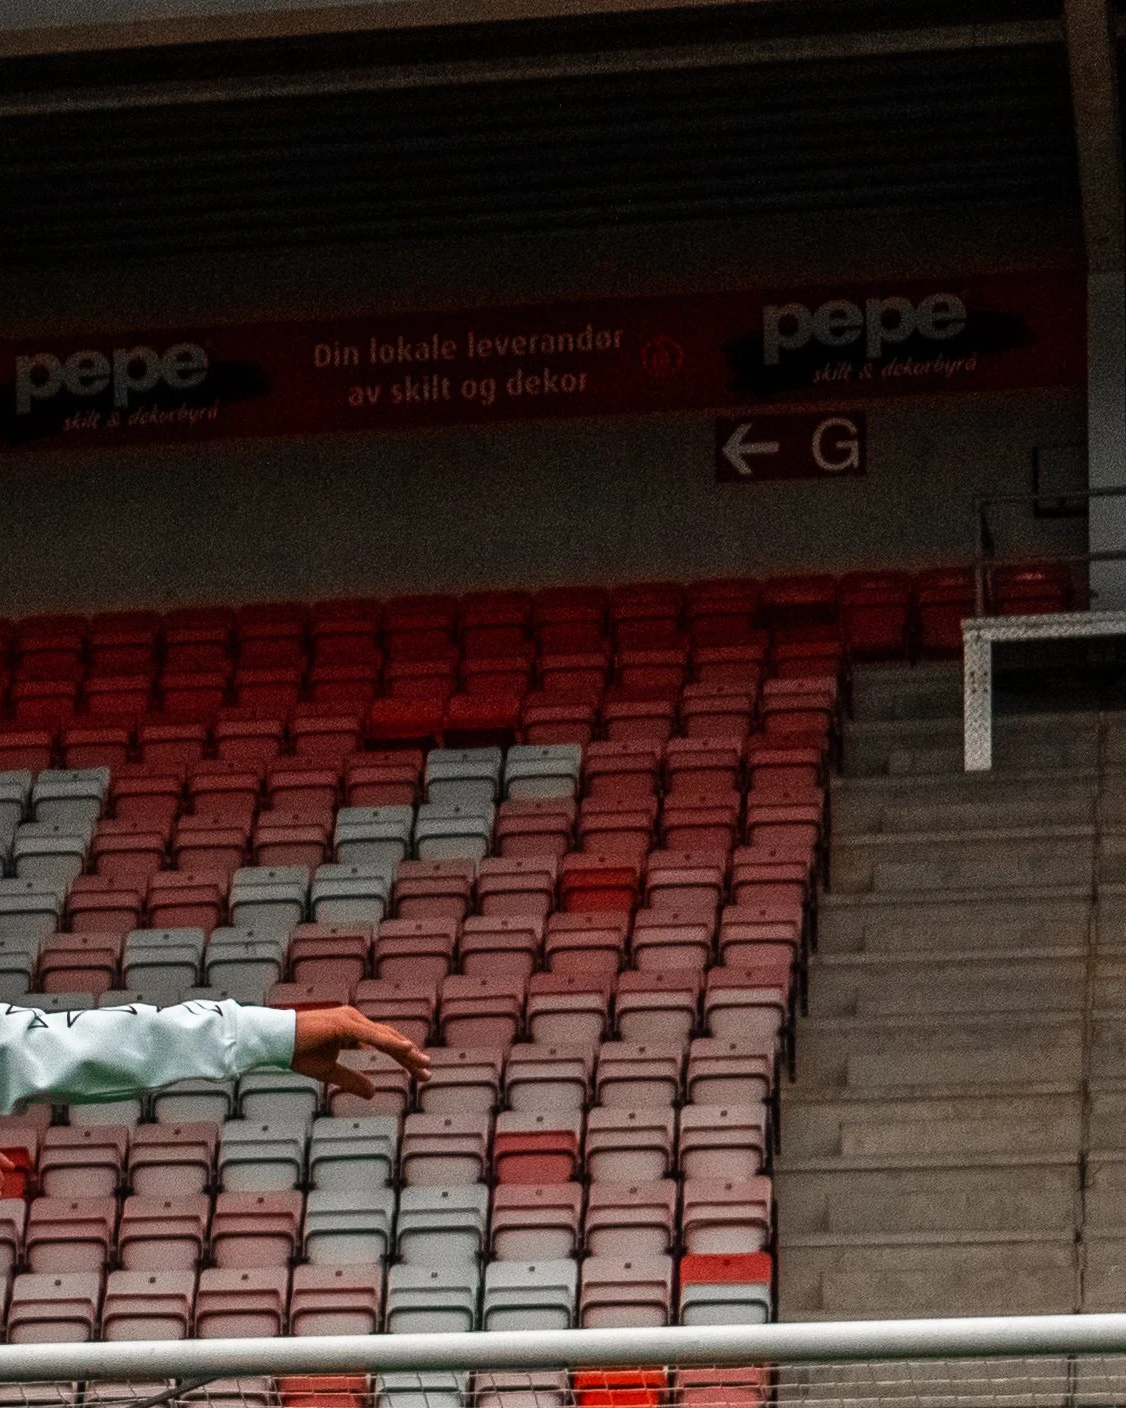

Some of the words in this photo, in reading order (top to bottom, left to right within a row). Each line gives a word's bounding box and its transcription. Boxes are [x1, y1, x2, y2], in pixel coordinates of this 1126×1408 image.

[313, 341, 360, 368] Din
[369, 333, 457, 365] lokale
[467, 322, 624, 359] leverandør
[762, 291, 967, 367] pepe
[14, 341, 209, 416] pepe
[348, 382, 381, 407] av
[390, 374, 452, 403] skilt
[461, 377, 496, 407] og
[506, 368, 589, 397] dekor
[812, 361, 854, 383] skilt
[857, 364, 875, 380] &
[810, 416, 860, 472] G
